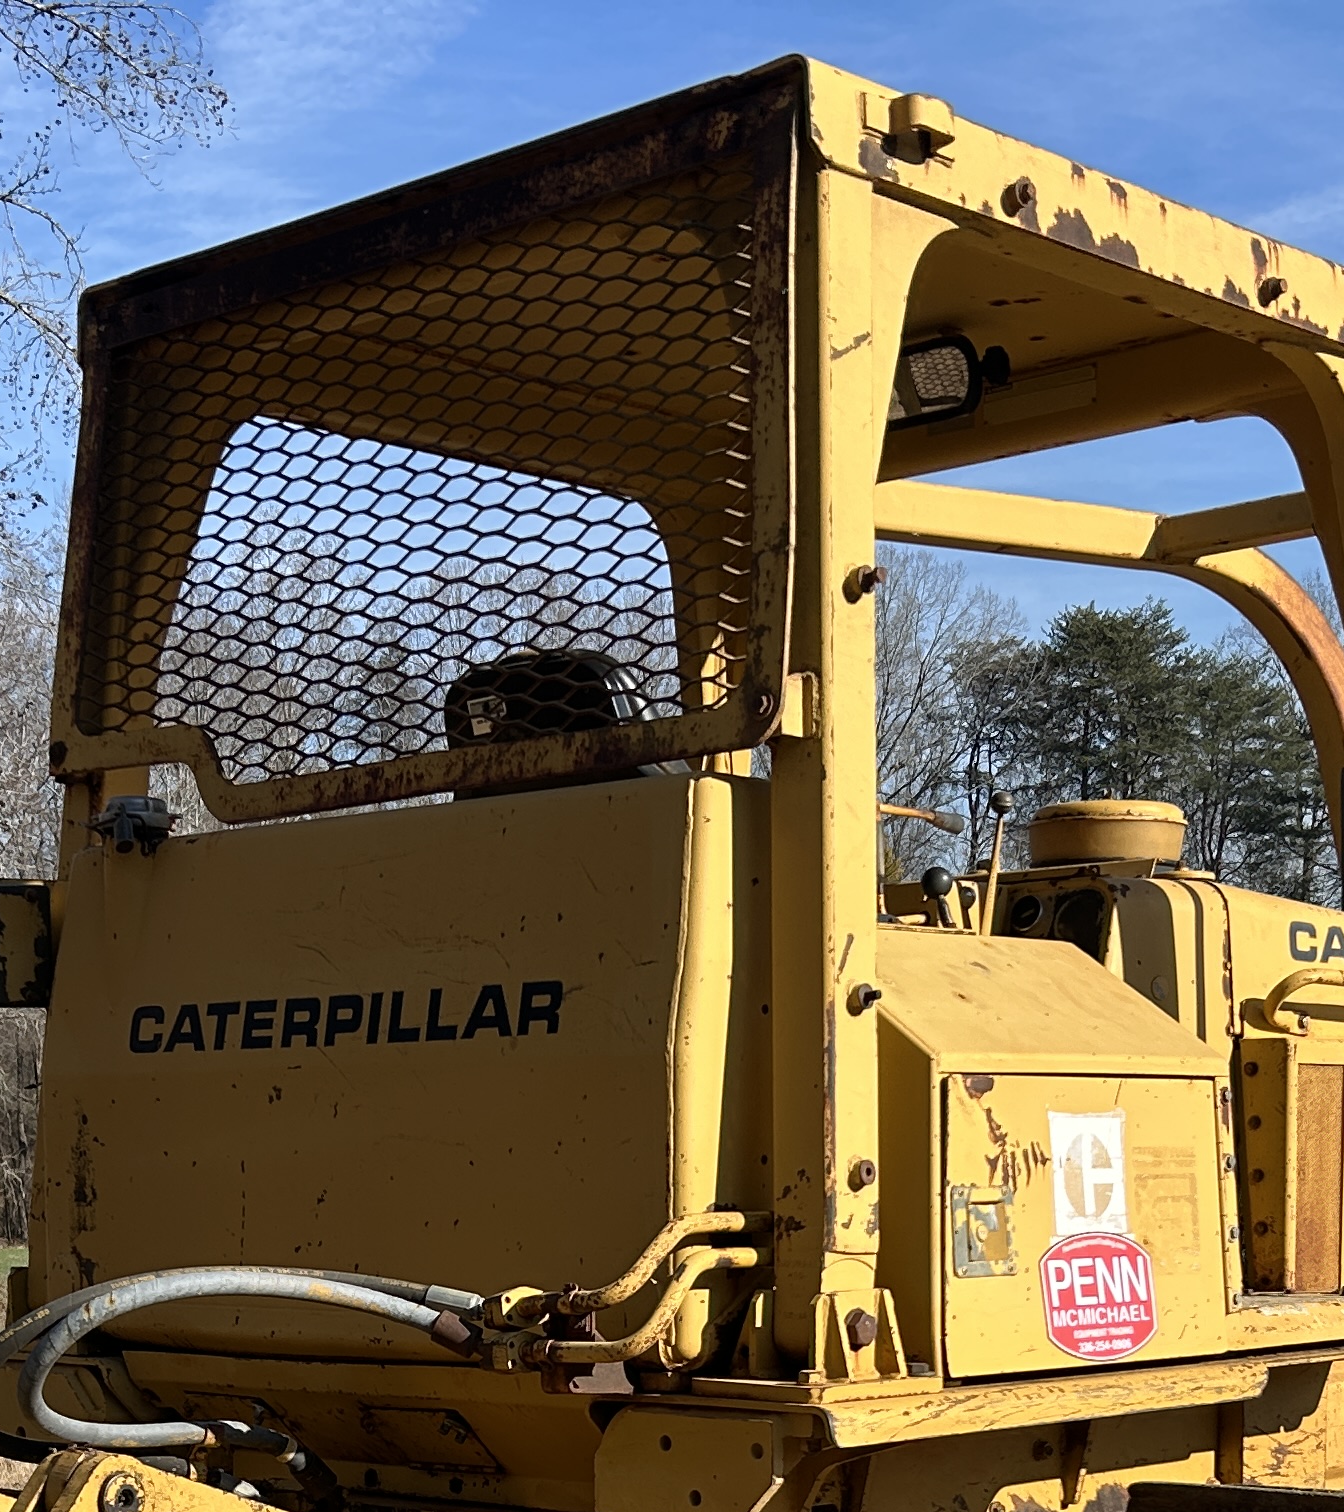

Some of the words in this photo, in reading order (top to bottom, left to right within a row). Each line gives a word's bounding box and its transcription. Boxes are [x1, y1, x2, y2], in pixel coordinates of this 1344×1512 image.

[129, 980, 564, 1054] CATERPILLAR
[1047, 1255, 1148, 1307] PENN
[1052, 1304, 1150, 1327] MCMICHAEL
